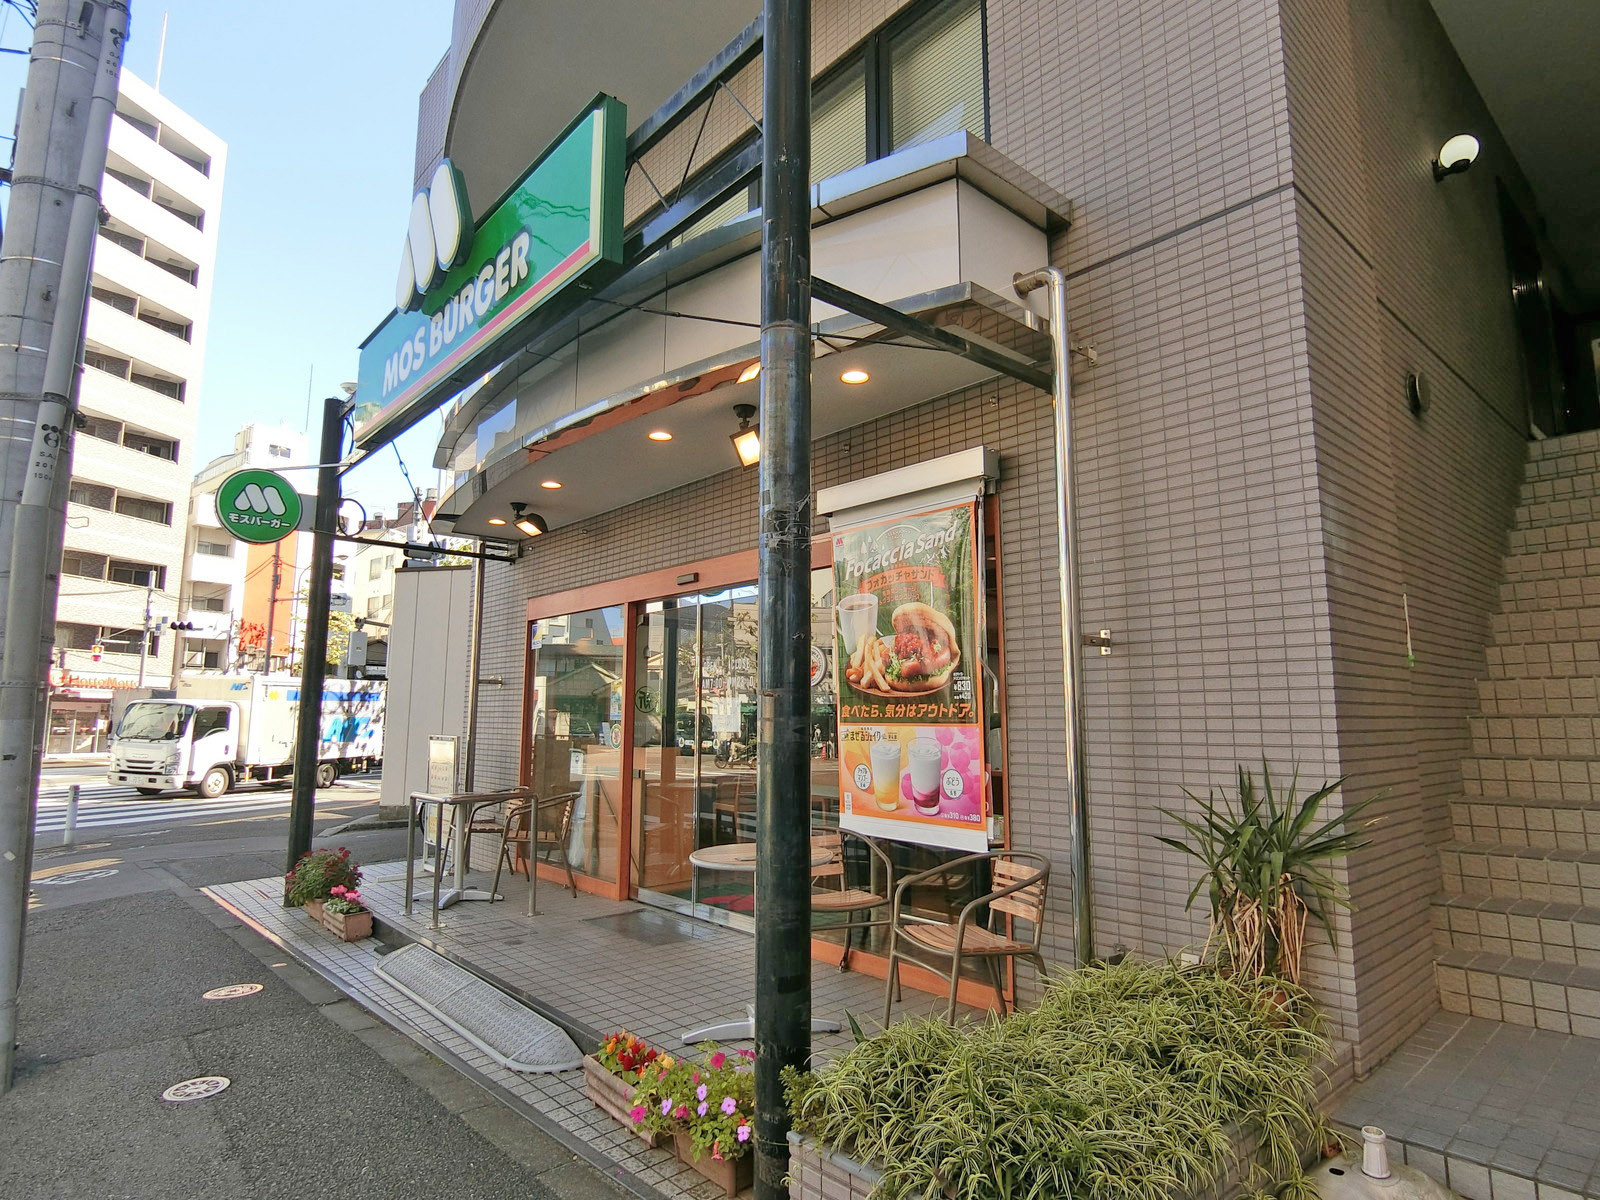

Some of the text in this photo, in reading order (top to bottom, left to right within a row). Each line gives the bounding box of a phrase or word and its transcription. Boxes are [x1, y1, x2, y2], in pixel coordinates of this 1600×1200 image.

[382, 231, 531, 398] MOS BURGER
[228, 512, 291, 528] モスバーガー
[845, 520, 958, 581] Focaccia Sand
[865, 568, 935, 591] フォカッチャサンド
[841, 703, 974, 718] 食べたら、気分はアウトドア。
